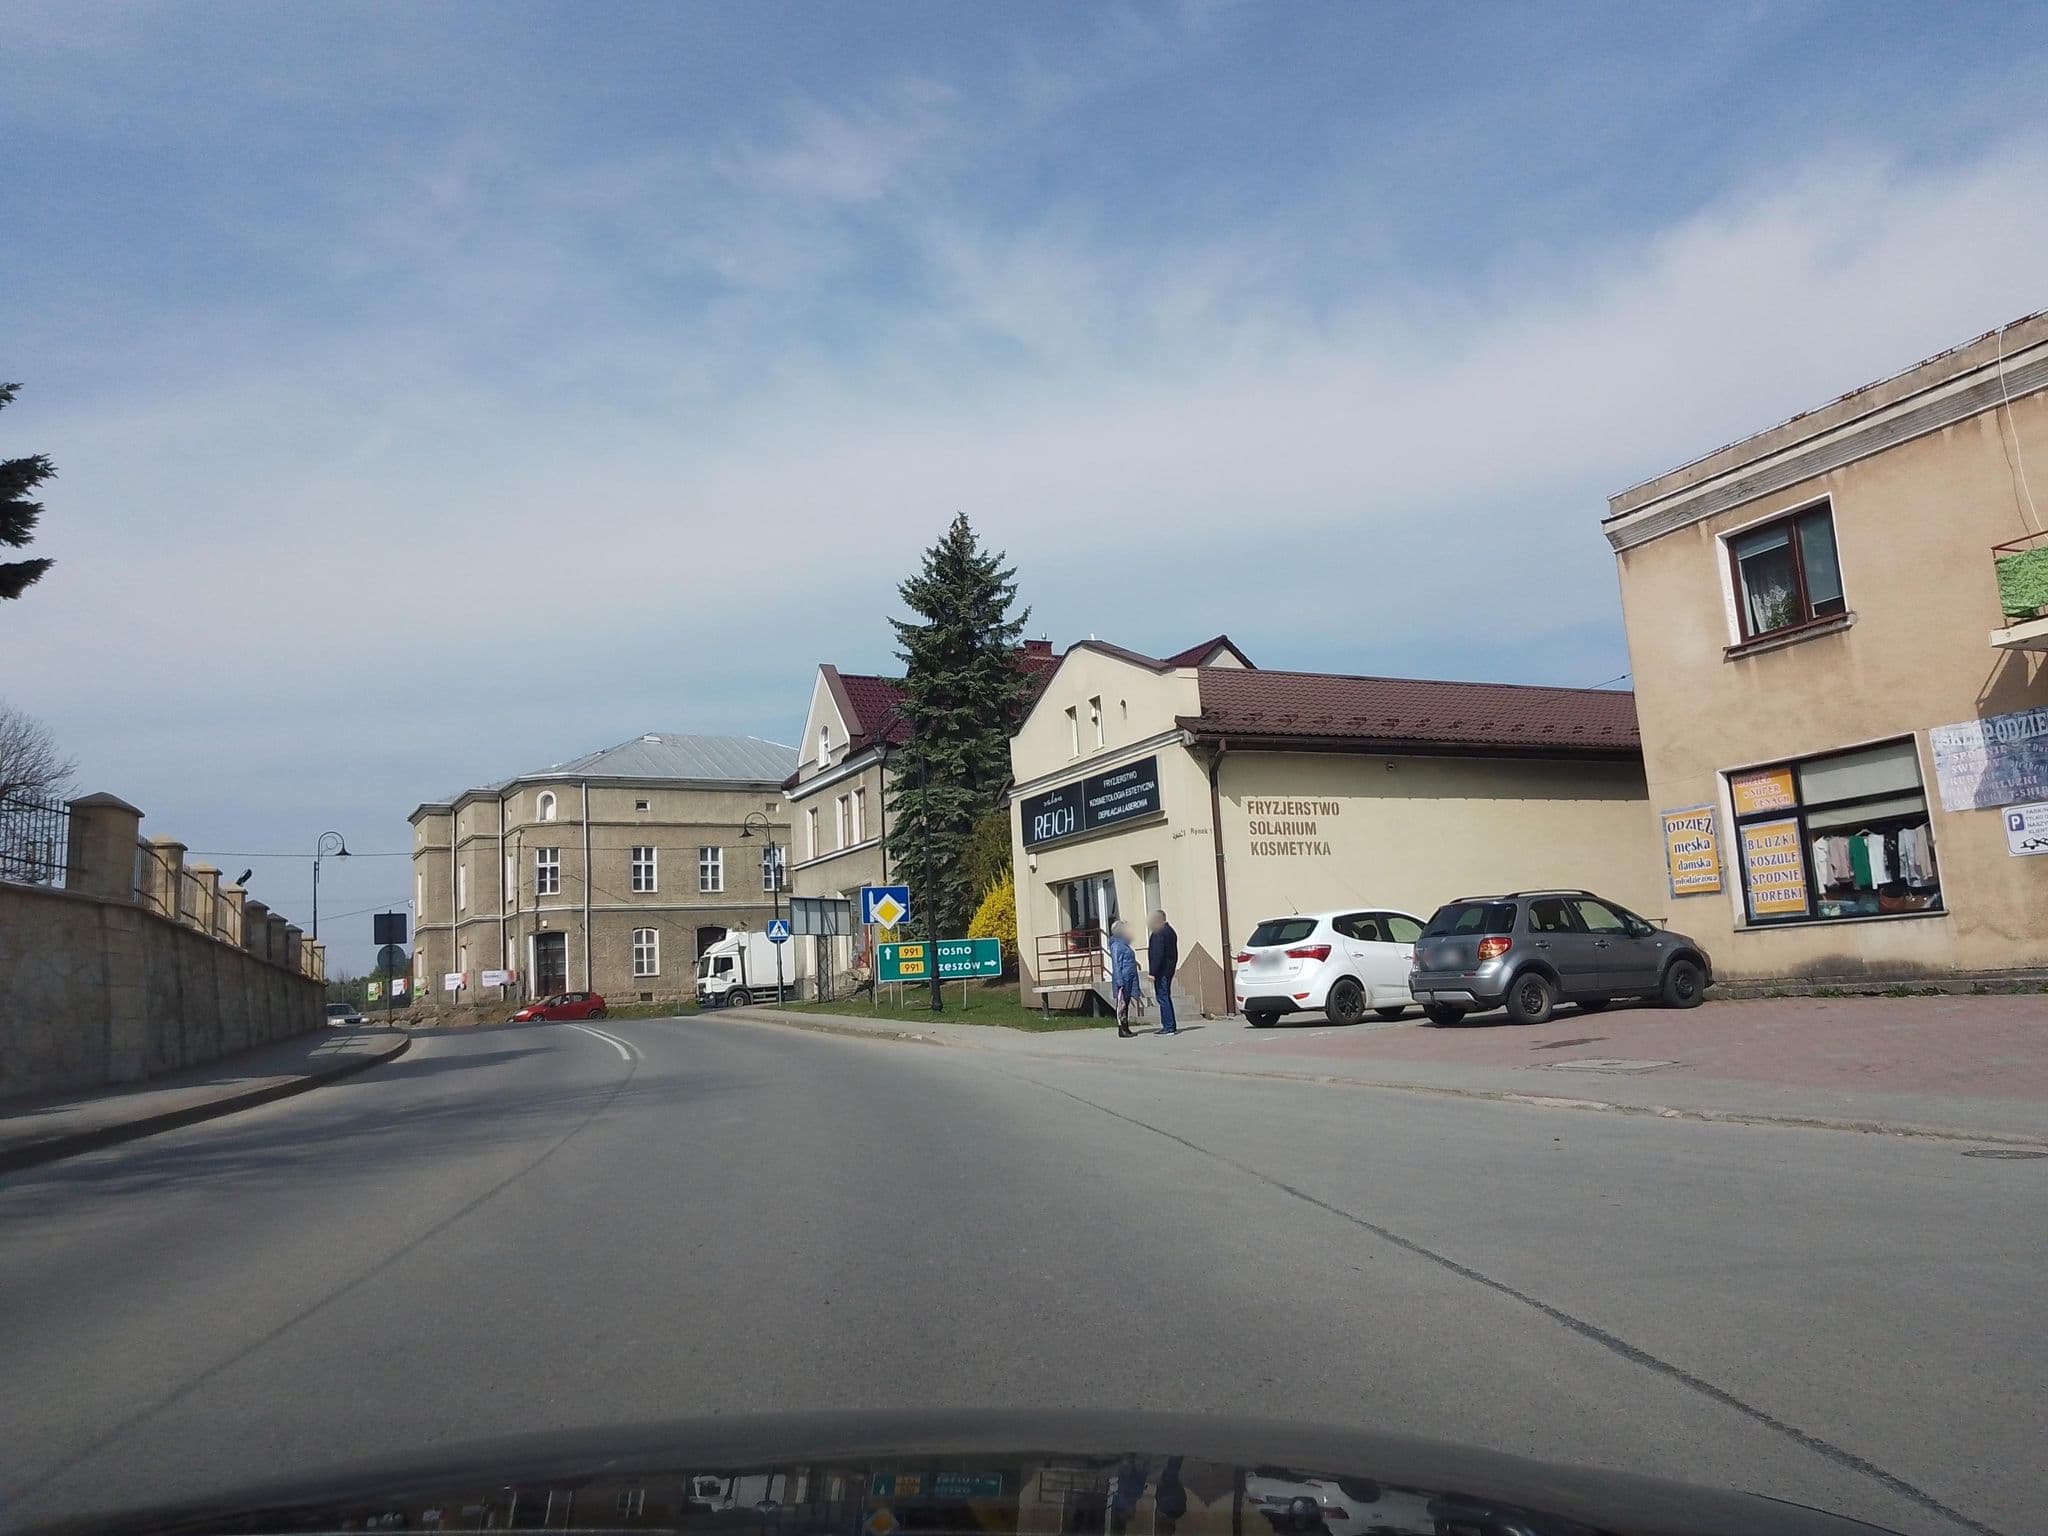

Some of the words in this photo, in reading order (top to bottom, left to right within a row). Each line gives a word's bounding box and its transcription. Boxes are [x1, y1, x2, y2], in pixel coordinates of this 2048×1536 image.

[1247, 800, 1340, 816] FRYZJERSTWO
[1034, 805, 1074, 841] REICH
[1249, 820, 1317, 836] SOLARIUM
[1667, 814, 1714, 836] ODZIEŻ
[1250, 841, 1332, 856] KOSMETYKA
[1674, 836, 1711, 855] męska
[1748, 835, 1796, 850] BLUZKI
[1678, 857, 1712, 871] damska
[1750, 852, 1798, 868] KOSZULE
[1752, 870, 1800, 885] SPODNIE
[1754, 887, 1803, 903] TOREBKI
[903, 947, 919, 956] 991
[938, 946, 972, 956] rosno
[904, 963, 920, 972] 991
[938, 959, 981, 972] zeszów
